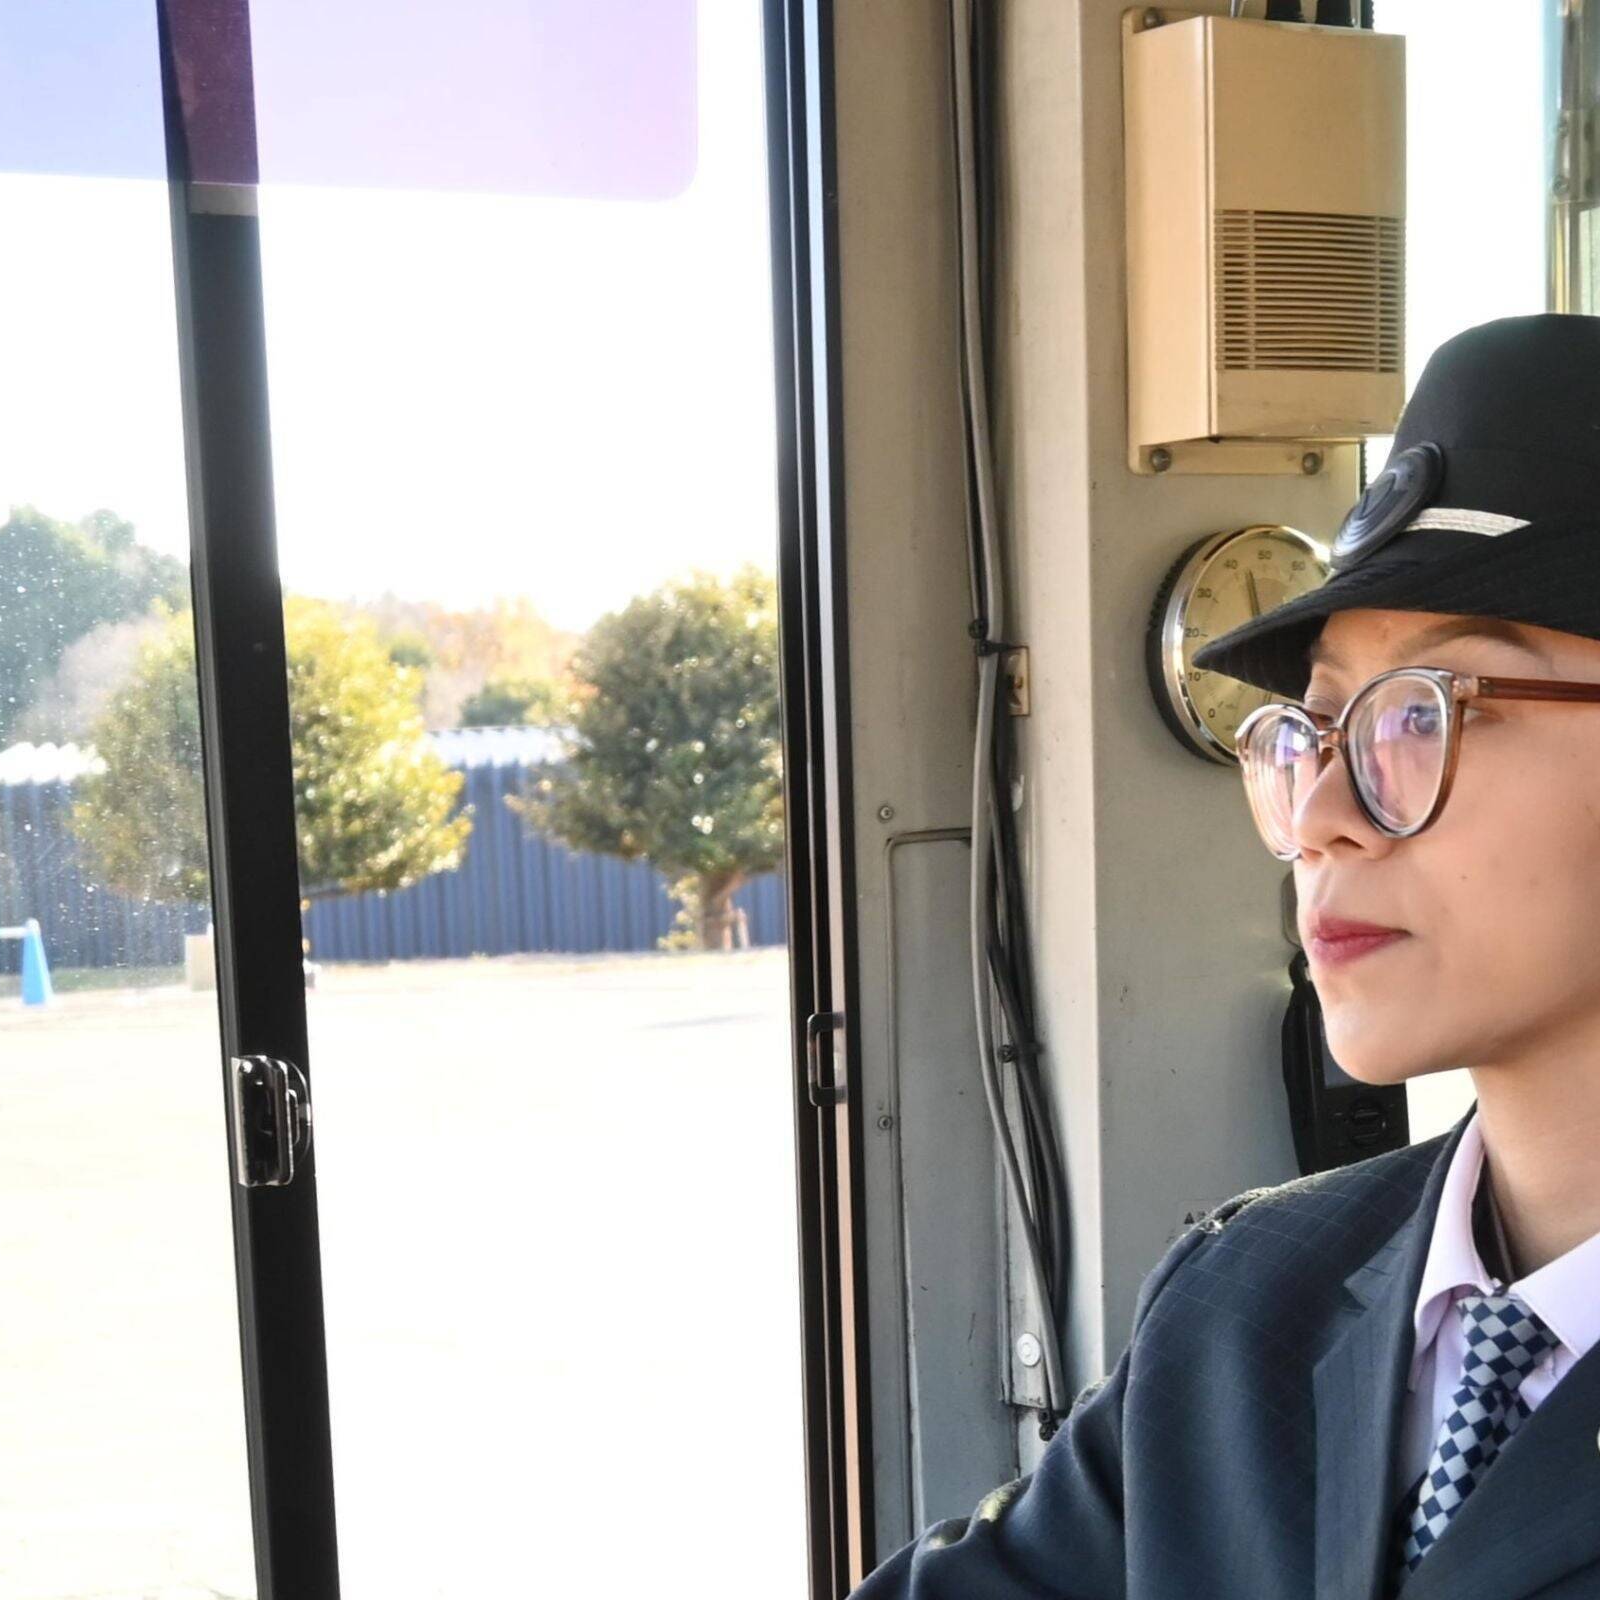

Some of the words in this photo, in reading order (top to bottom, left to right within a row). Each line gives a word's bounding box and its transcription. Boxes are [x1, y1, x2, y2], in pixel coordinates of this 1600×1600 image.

[1258, 551, 1272, 560] 50
[1224, 560, 1238, 570] 40
[1197, 588, 1212, 598] 30
[1185, 628, 1199, 638] 20
[1188, 672, 1200, 682] 10
